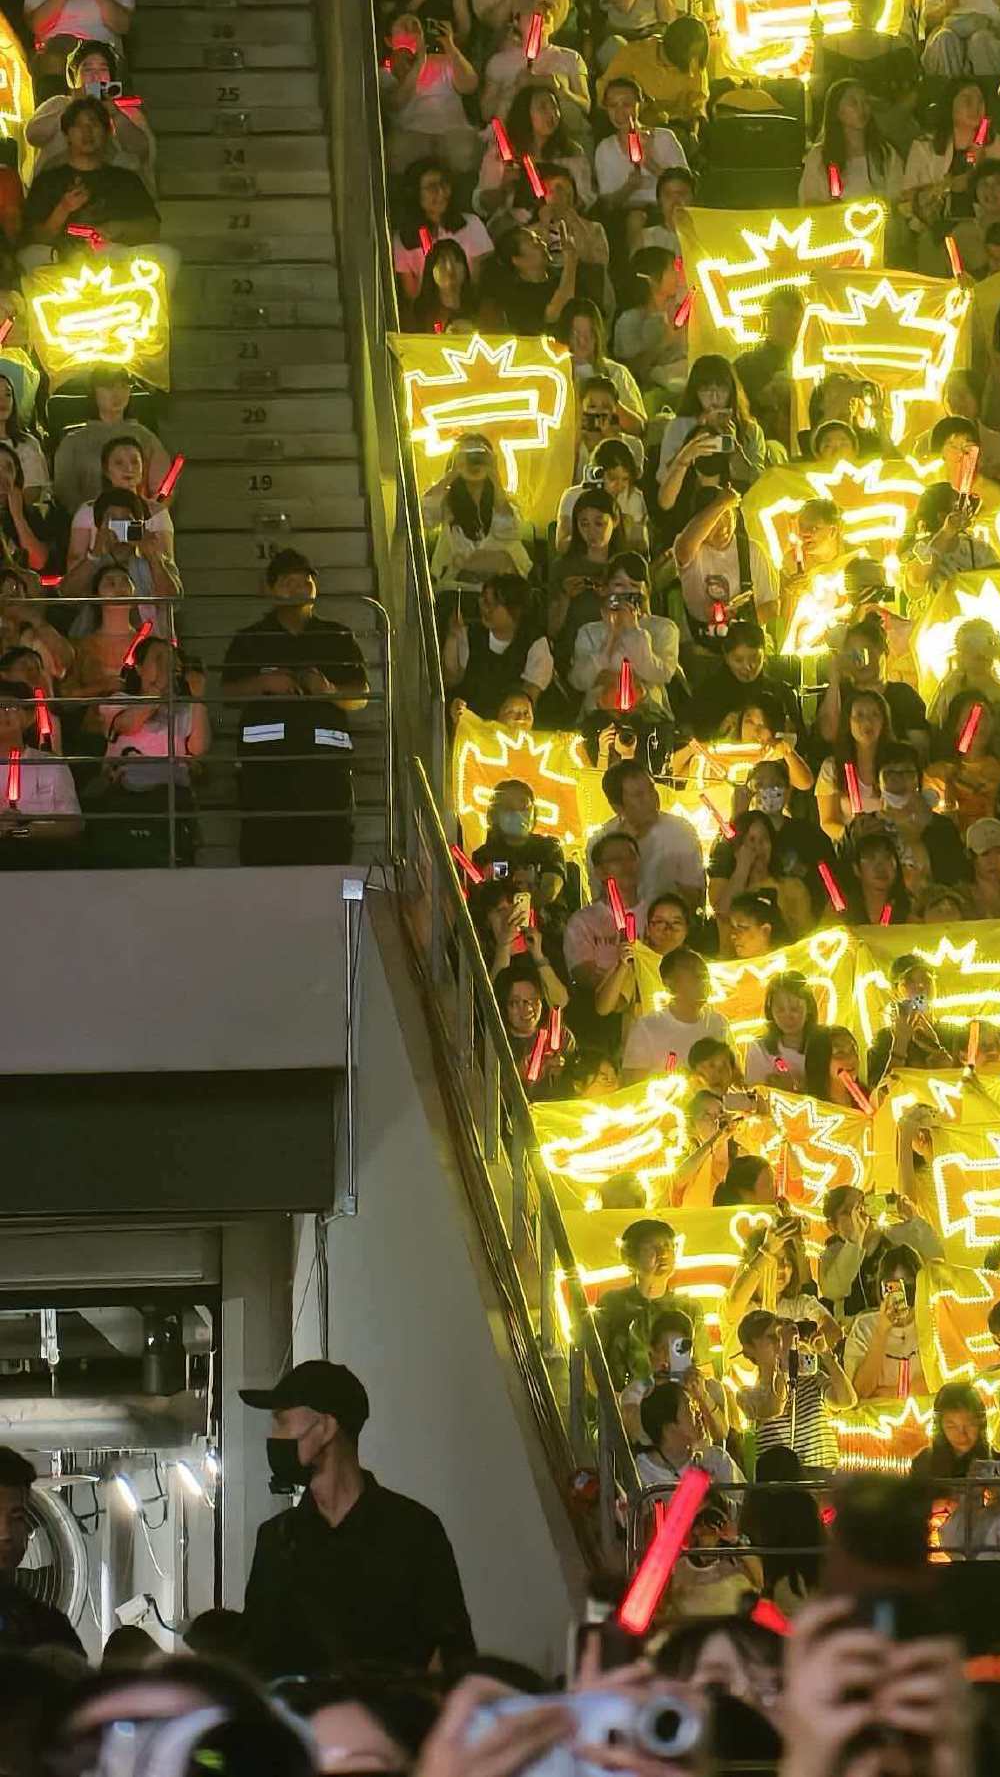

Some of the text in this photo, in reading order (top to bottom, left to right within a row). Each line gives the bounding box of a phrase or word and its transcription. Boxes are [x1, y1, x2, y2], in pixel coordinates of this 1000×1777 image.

[217, 87, 240, 102] 25
[223, 150, 245, 165] 24
[241, 407, 266, 423] 20
[248, 475, 273, 490] 19
